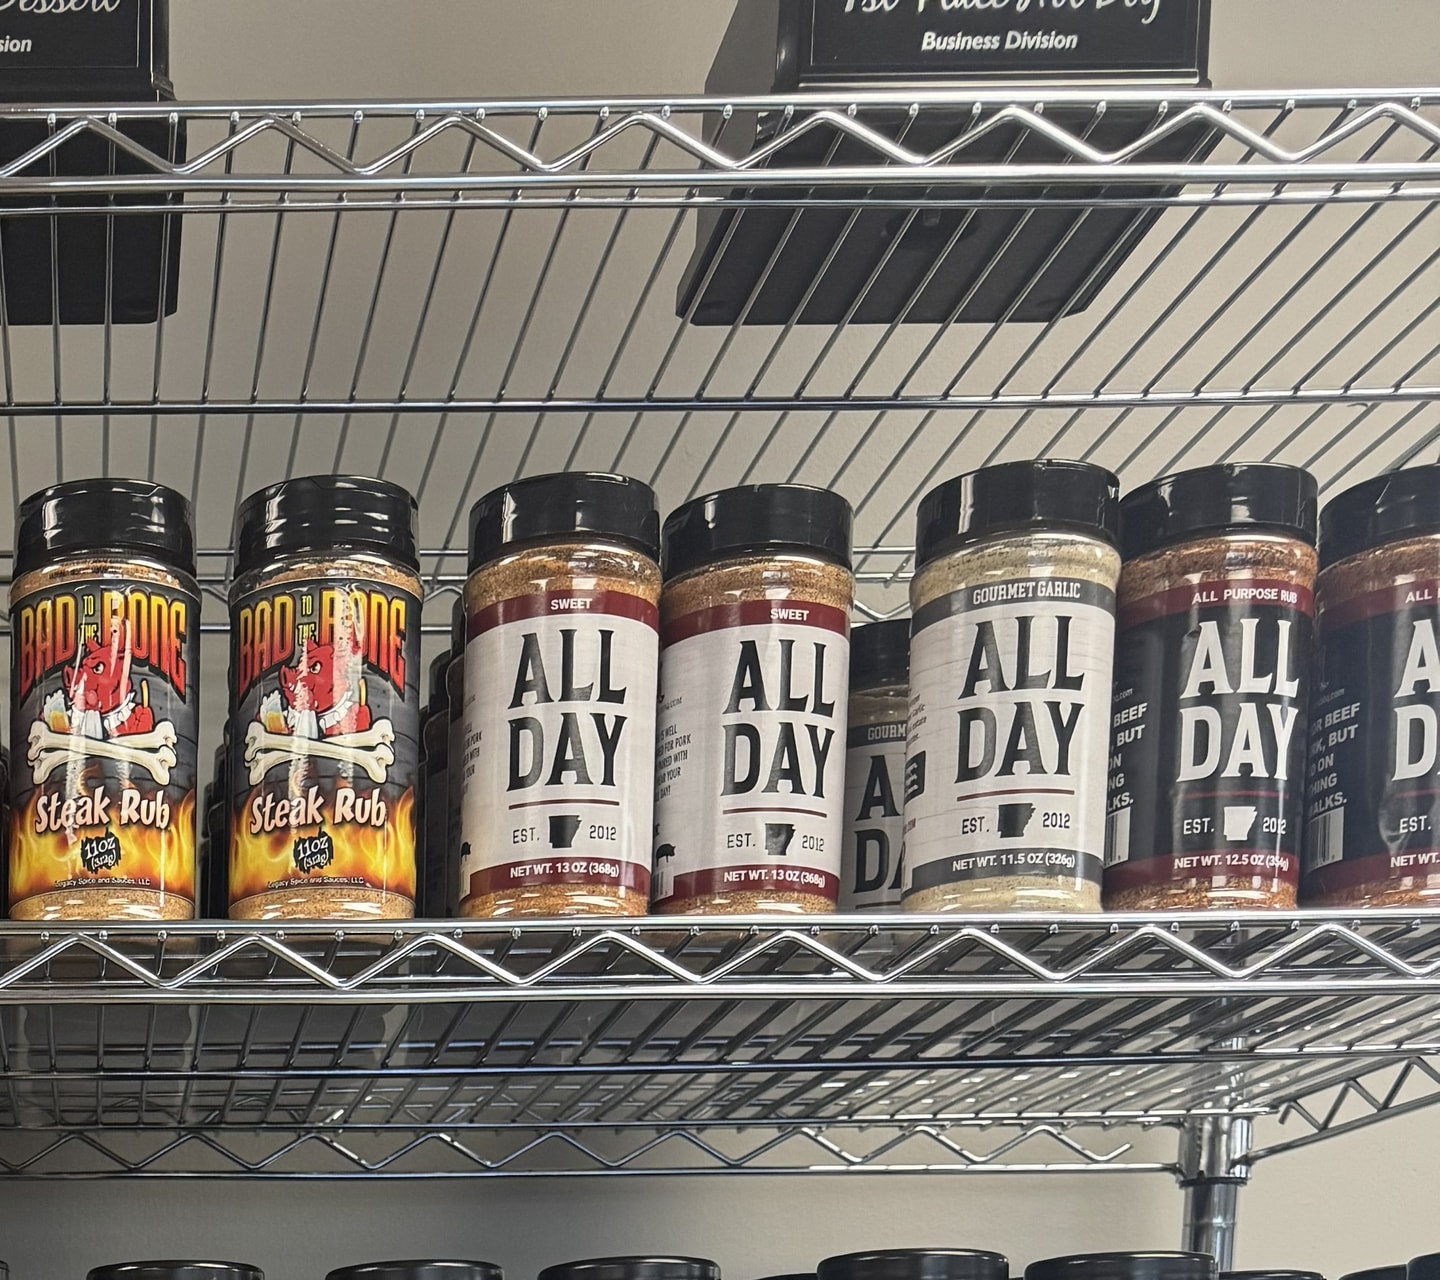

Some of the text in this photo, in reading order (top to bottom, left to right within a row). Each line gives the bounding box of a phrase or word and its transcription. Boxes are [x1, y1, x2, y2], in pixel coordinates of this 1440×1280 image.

[921, 31, 1078, 51] Business Division
[550, 598, 592, 611] SWEET
[973, 581, 1081, 605] GOURMET GARLIC
[1192, 588, 1298, 605] ALL PURPOSE RUB
[508, 629, 627, 709] ALL
[959, 615, 1086, 700] ALL
[506, 712, 628, 792] DAY
[954, 701, 1085, 784] DAY
[250, 785, 386, 835] Steak Rub
[512, 824, 617, 844] EST. 2012
[510, 862, 620, 878] NET WT. 13 OZ (368g)
